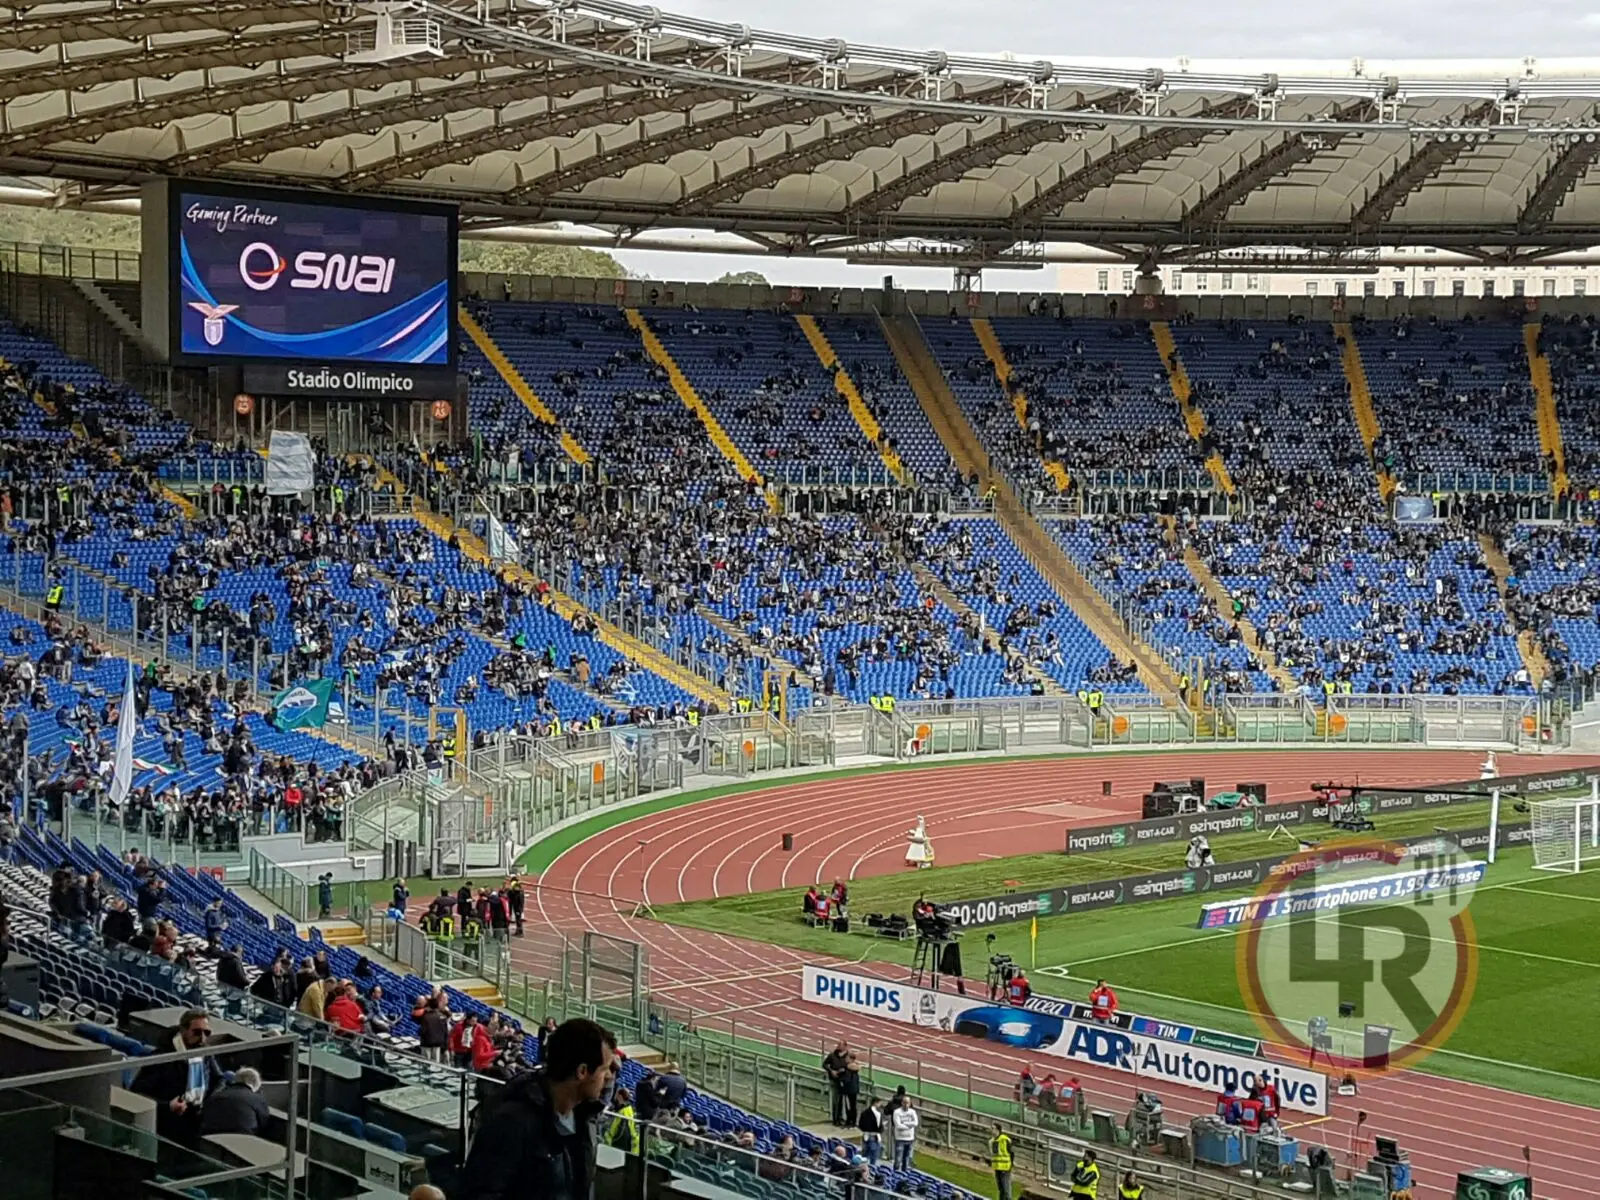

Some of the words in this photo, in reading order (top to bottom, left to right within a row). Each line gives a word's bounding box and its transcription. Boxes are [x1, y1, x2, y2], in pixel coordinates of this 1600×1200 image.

[186, 202, 231, 233] Gaming
[232, 204, 278, 226] Partner
[287, 370, 341, 391] Stadio
[343, 371, 413, 395] Olimpico
[1213, 869, 1253, 883] RENT-A-CAR
[1071, 889, 1115, 905] RENT-A-CAR
[1227, 903, 1260, 923] TIM
[1267, 901, 1278, 917] 1
[1281, 884, 1377, 913] Smartphone
[1380, 884, 1391, 897] a
[816, 974, 901, 1013] PHILIPS
[1023, 997, 1066, 1016] acea
[1157, 1024, 1180, 1040] TIM
[1067, 1024, 1133, 1070] ADR
